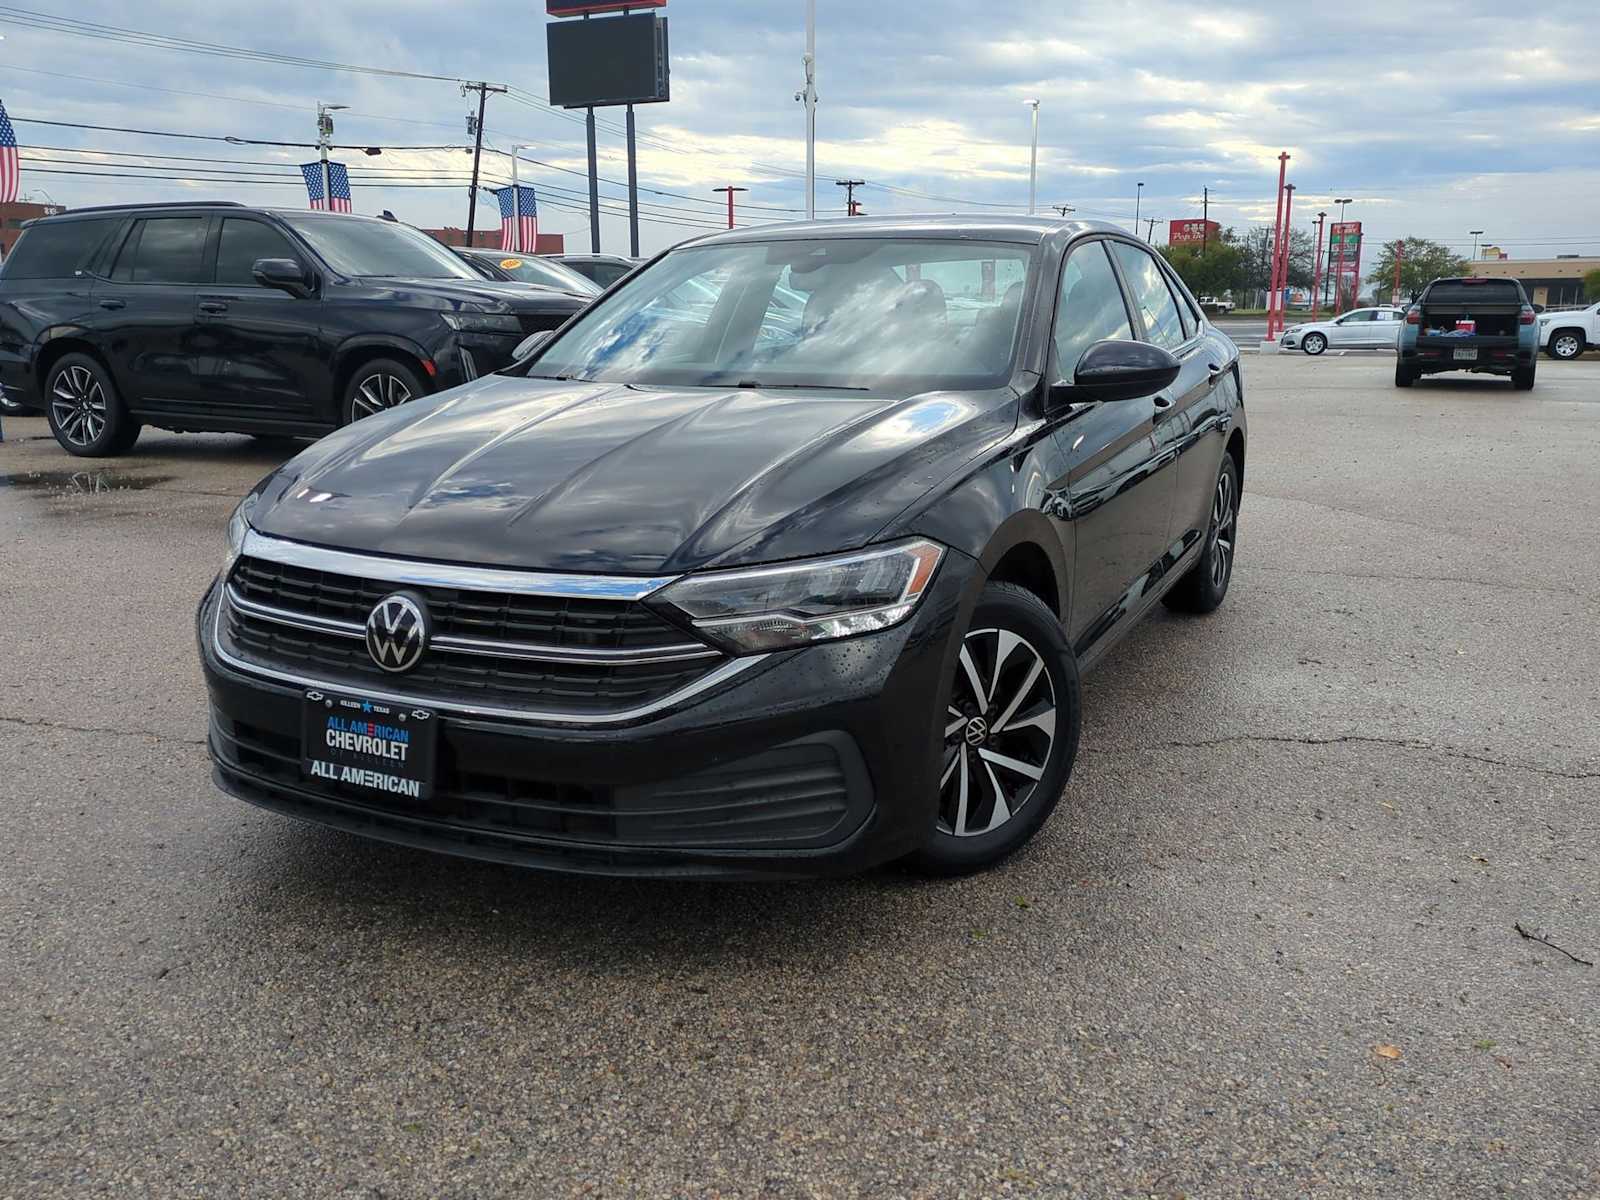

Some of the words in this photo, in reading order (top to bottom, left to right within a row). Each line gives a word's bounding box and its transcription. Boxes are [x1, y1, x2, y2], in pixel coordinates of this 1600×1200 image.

[373, 705, 390, 714] TEXAS
[327, 716, 347, 731] ALL
[349, 720, 409, 743] AMERICAN
[326, 729, 409, 760] CHEVROLET
[310, 760, 338, 780] ALL
[340, 766, 420, 798] AMERICAN
